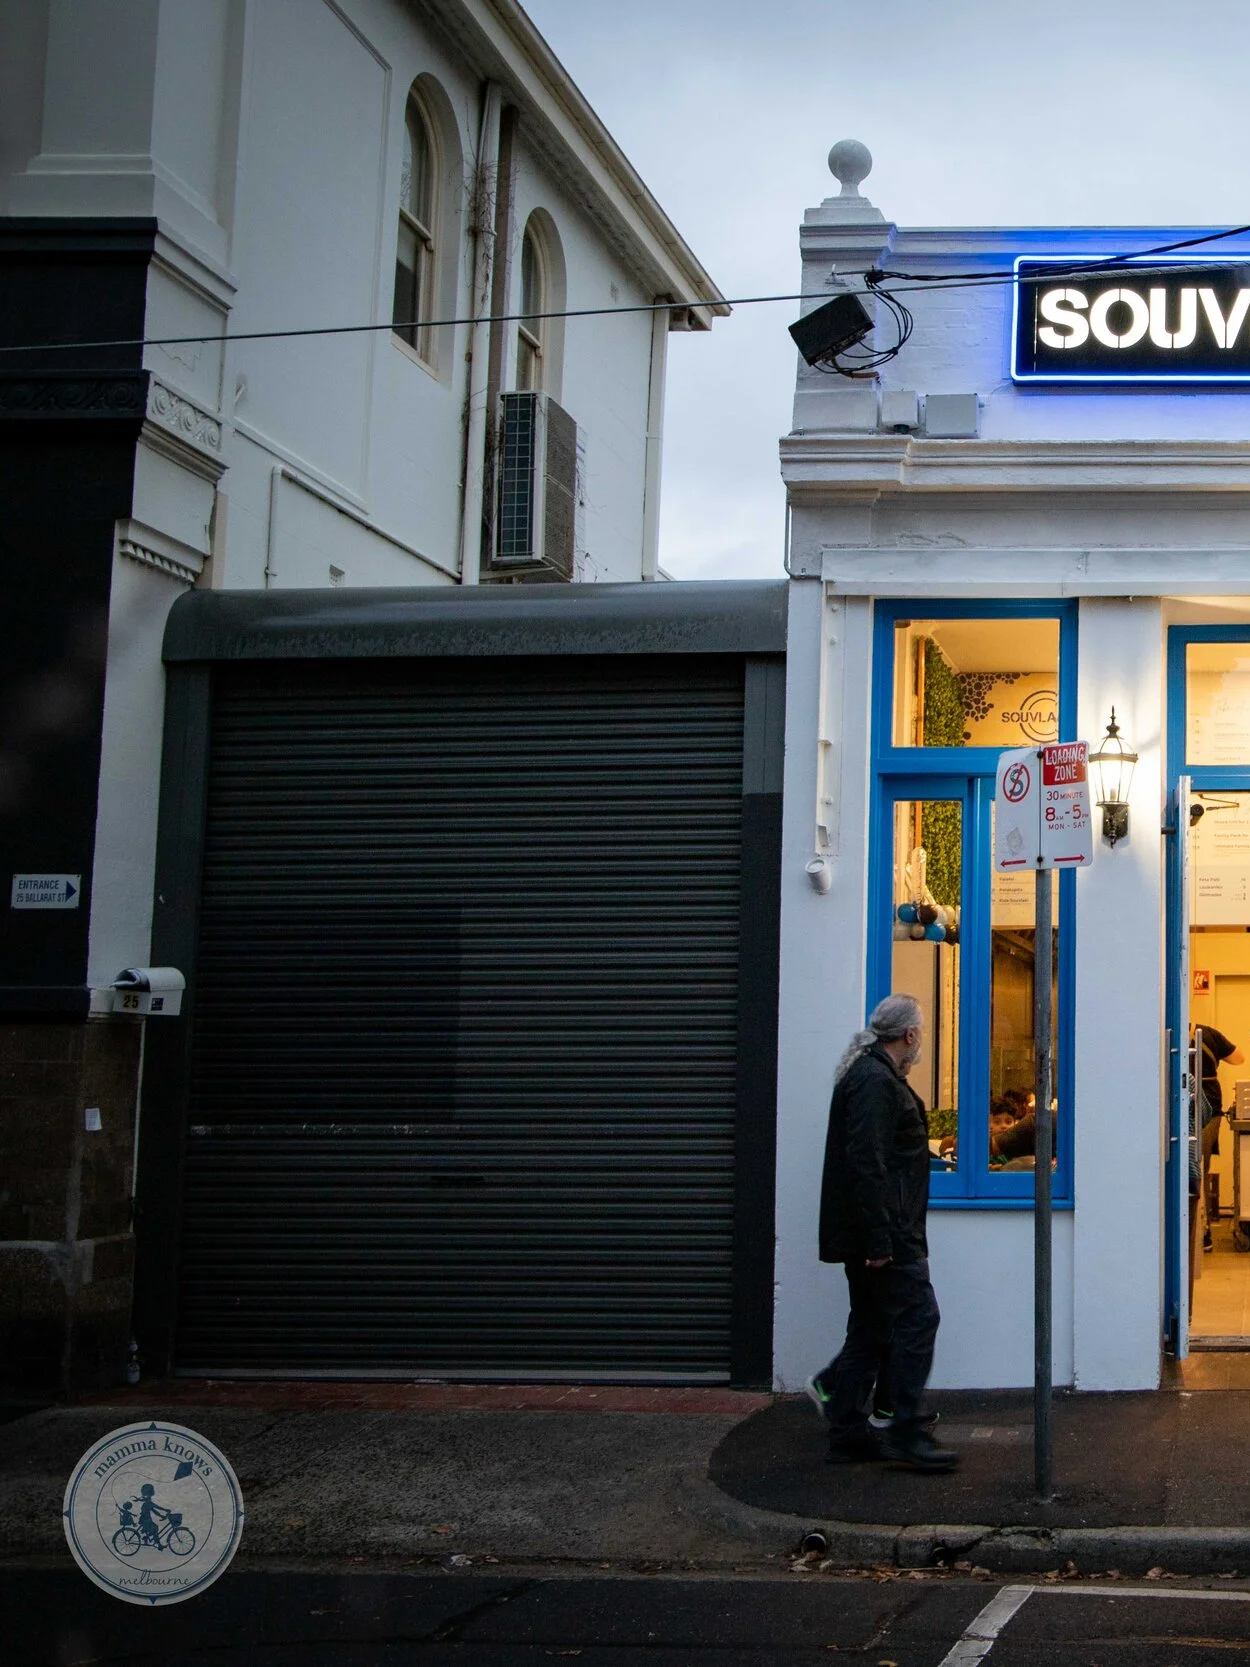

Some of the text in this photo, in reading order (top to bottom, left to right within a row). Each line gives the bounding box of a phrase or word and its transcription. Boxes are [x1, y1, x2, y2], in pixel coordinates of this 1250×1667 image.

[1045, 746, 1084, 766] LOADING
[1054, 764, 1078, 782] ZONE
[1046, 790, 1084, 801] 30 MINUTE
[1048, 822, 1065, 831] MON
[1072, 820, 1086, 830] SAT
[18, 879, 60, 891] ENTRANCE
[16, 892, 24, 903] 25
[26, 892, 56, 903] BALLARAT
[123, 995, 140, 1009] 25
